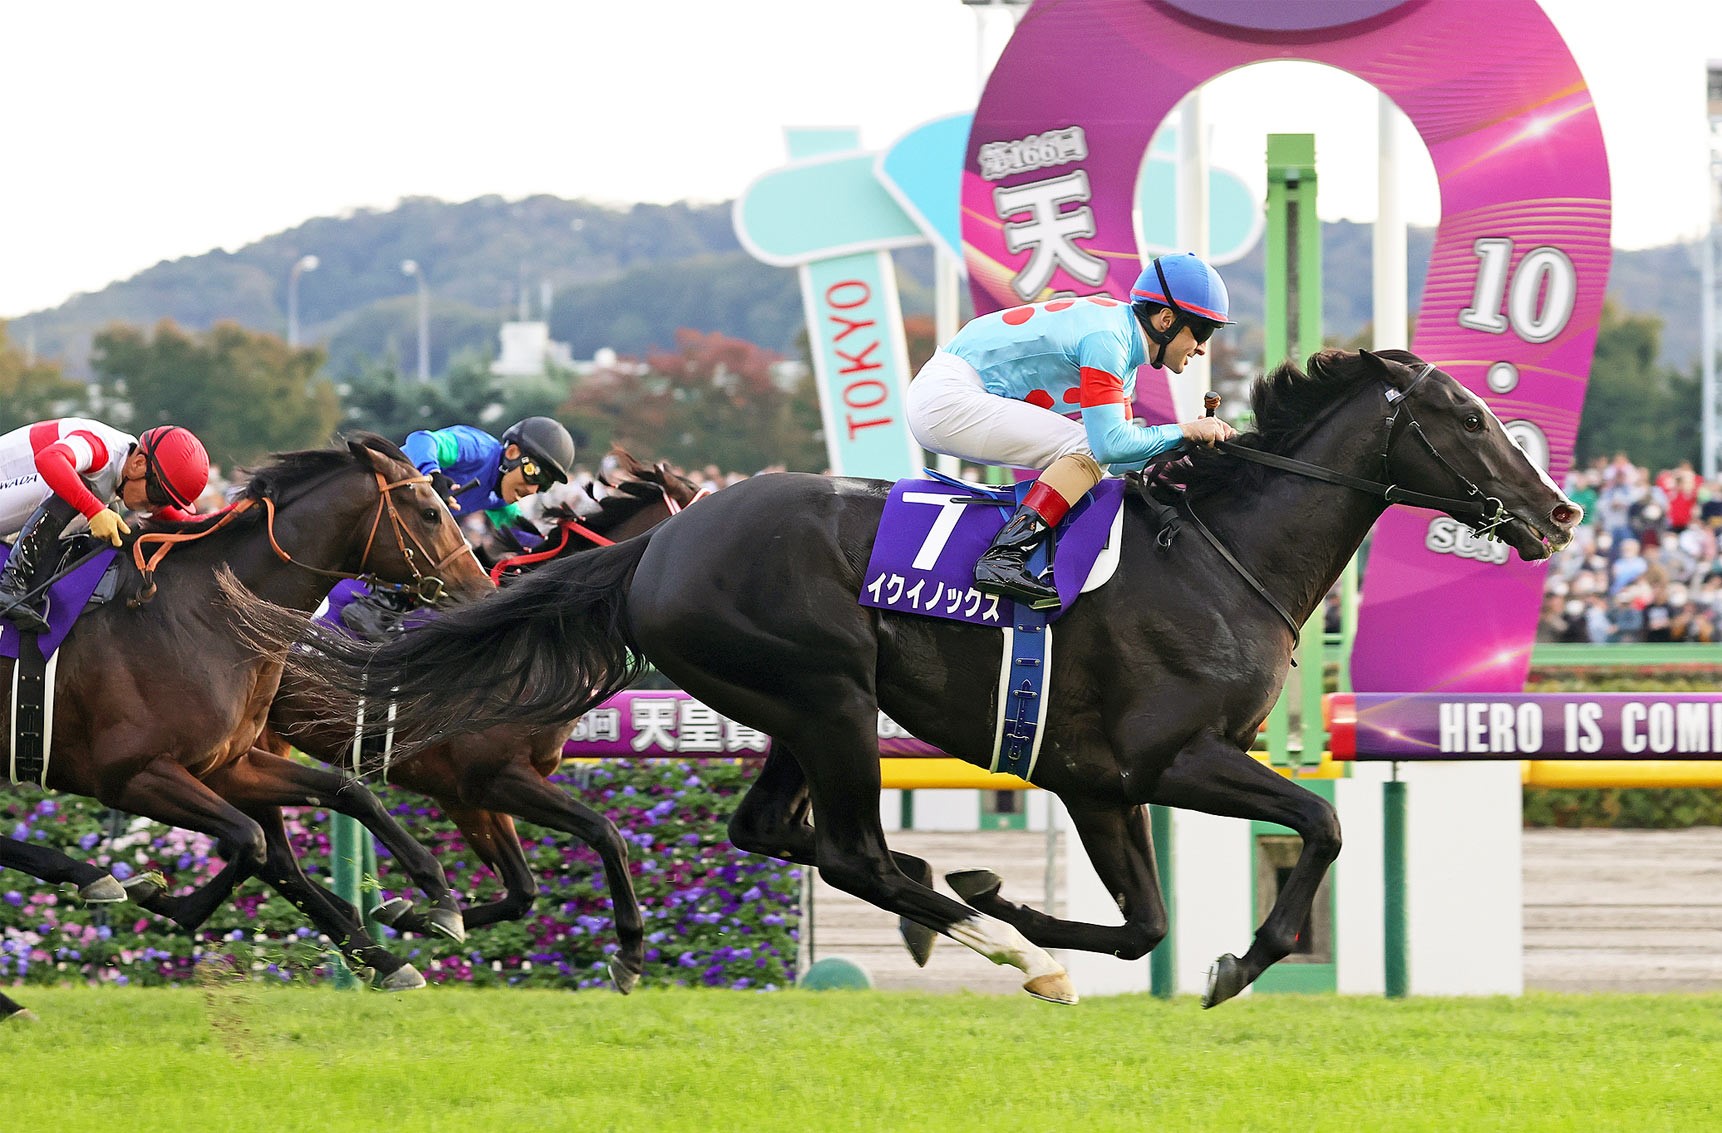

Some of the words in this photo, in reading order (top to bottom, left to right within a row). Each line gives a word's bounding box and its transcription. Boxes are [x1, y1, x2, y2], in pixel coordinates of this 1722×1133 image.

[825, 279, 893, 442] TOKYO
[902, 491, 973, 571] 7
[867, 572, 1000, 622] イクイノックス
[1439, 702, 1544, 754] HERO
[1564, 702, 1604, 754] IS
